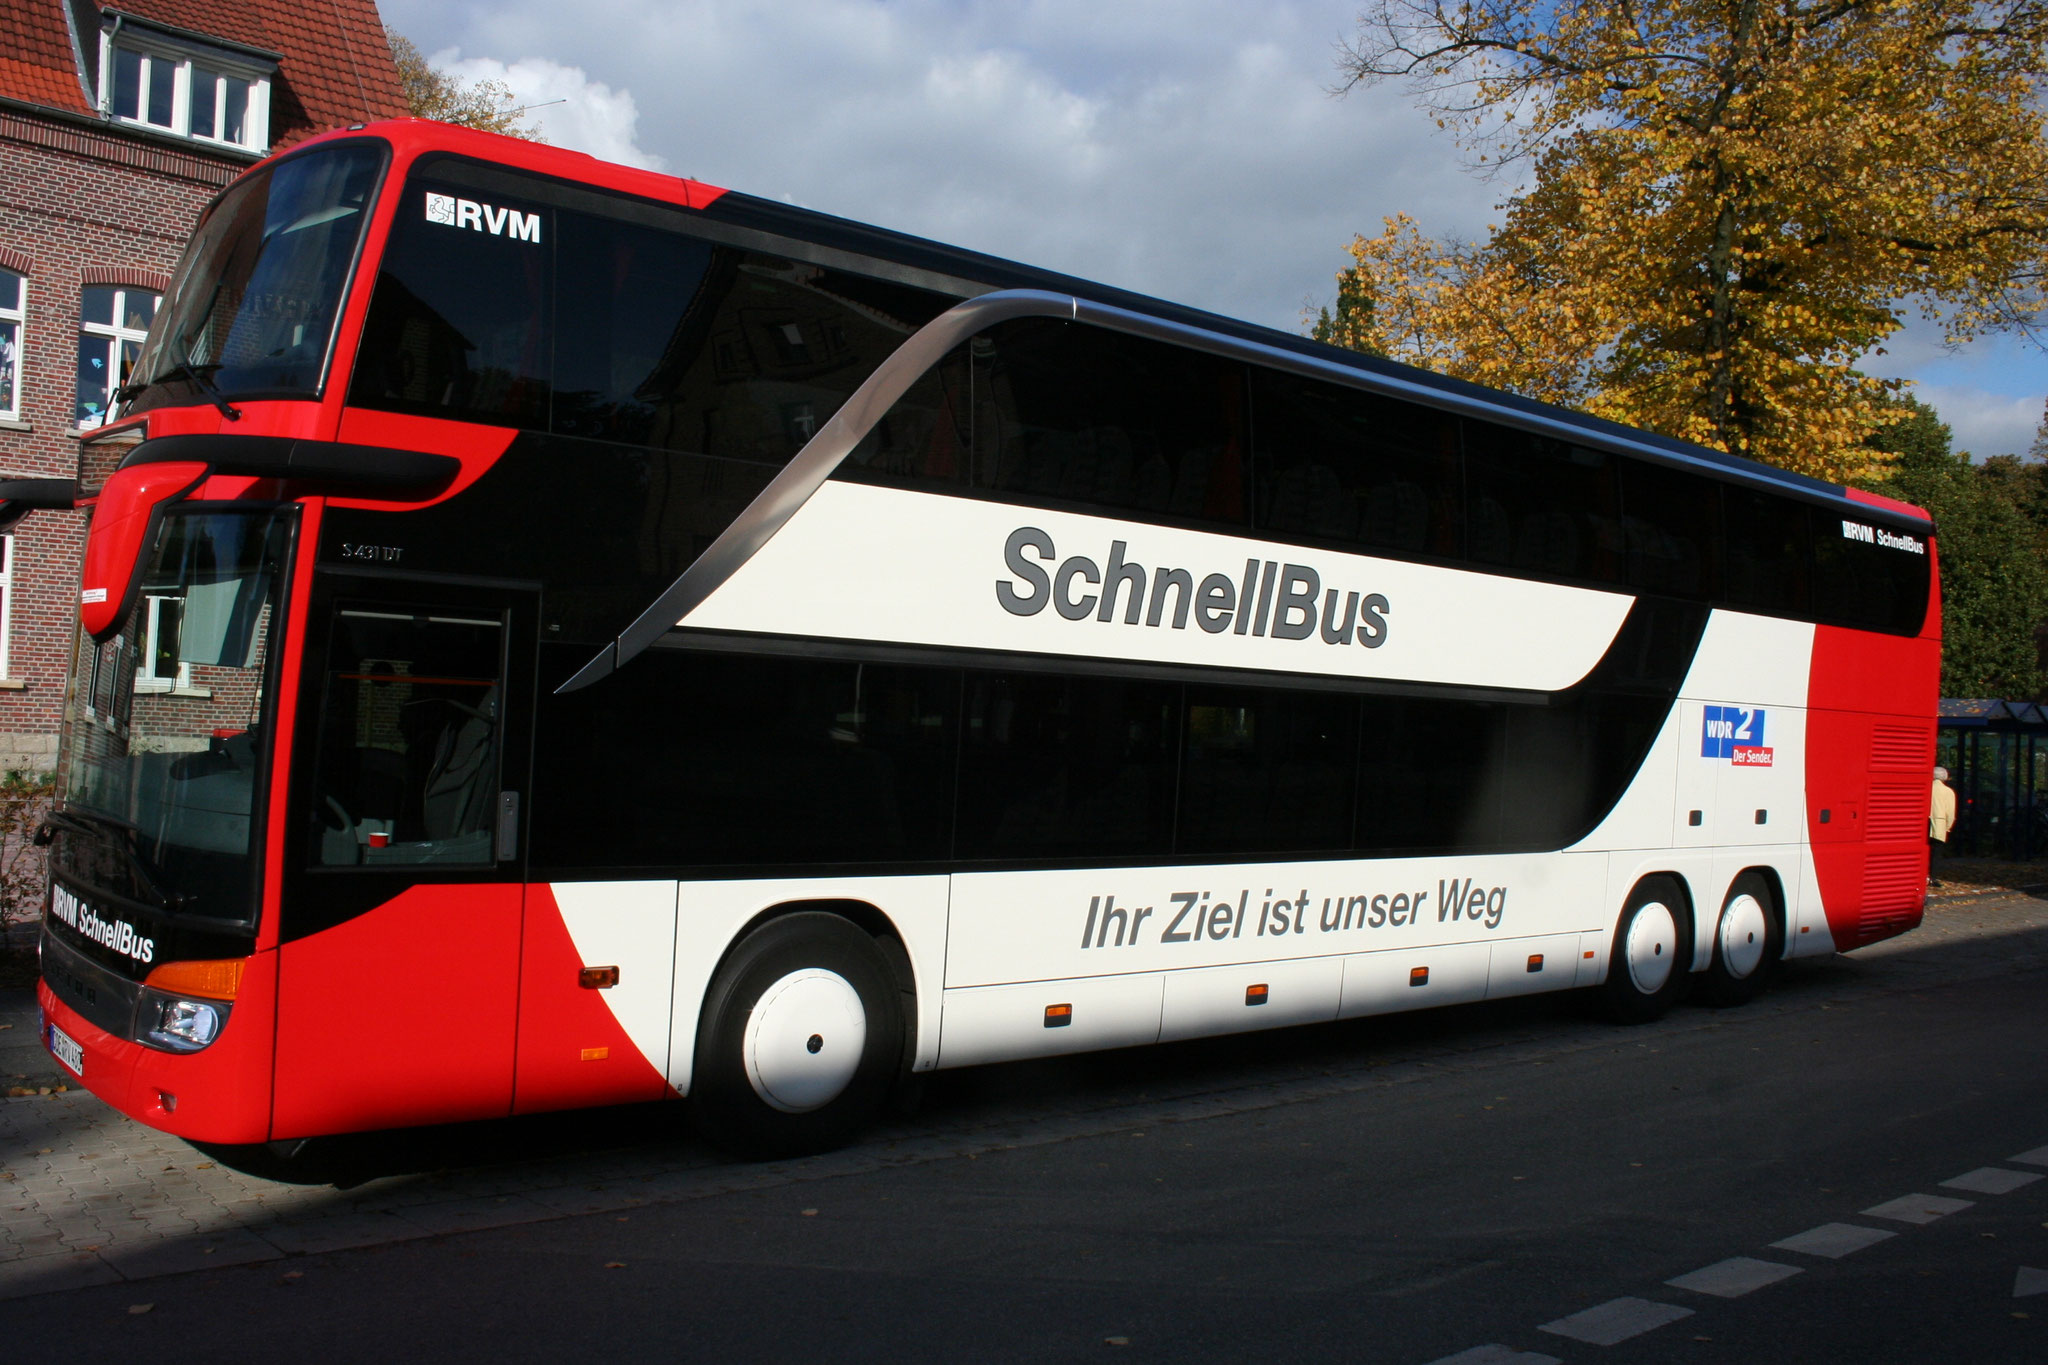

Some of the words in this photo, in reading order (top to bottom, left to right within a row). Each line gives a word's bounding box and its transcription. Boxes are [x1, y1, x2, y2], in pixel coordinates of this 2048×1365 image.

[457, 199, 540, 243] RVM
[1851, 522, 1874, 543] RVM
[1876, 528, 1924, 554] SchnellBus
[996, 526, 1390, 649] SchnellBus
[1706, 719, 1732, 739] WDR
[1734, 707, 1755, 739] 2
[1733, 749, 1746, 762] Der
[58, 887, 78, 928] RVM
[79, 902, 154, 963] SchnellBus
[1080, 895, 1153, 948] Ihr
[1160, 889, 1249, 943] Ziel
[1257, 888, 1310, 937] ist
[1319, 891, 1427, 932] unser
[1437, 878, 1508, 929] Weg
